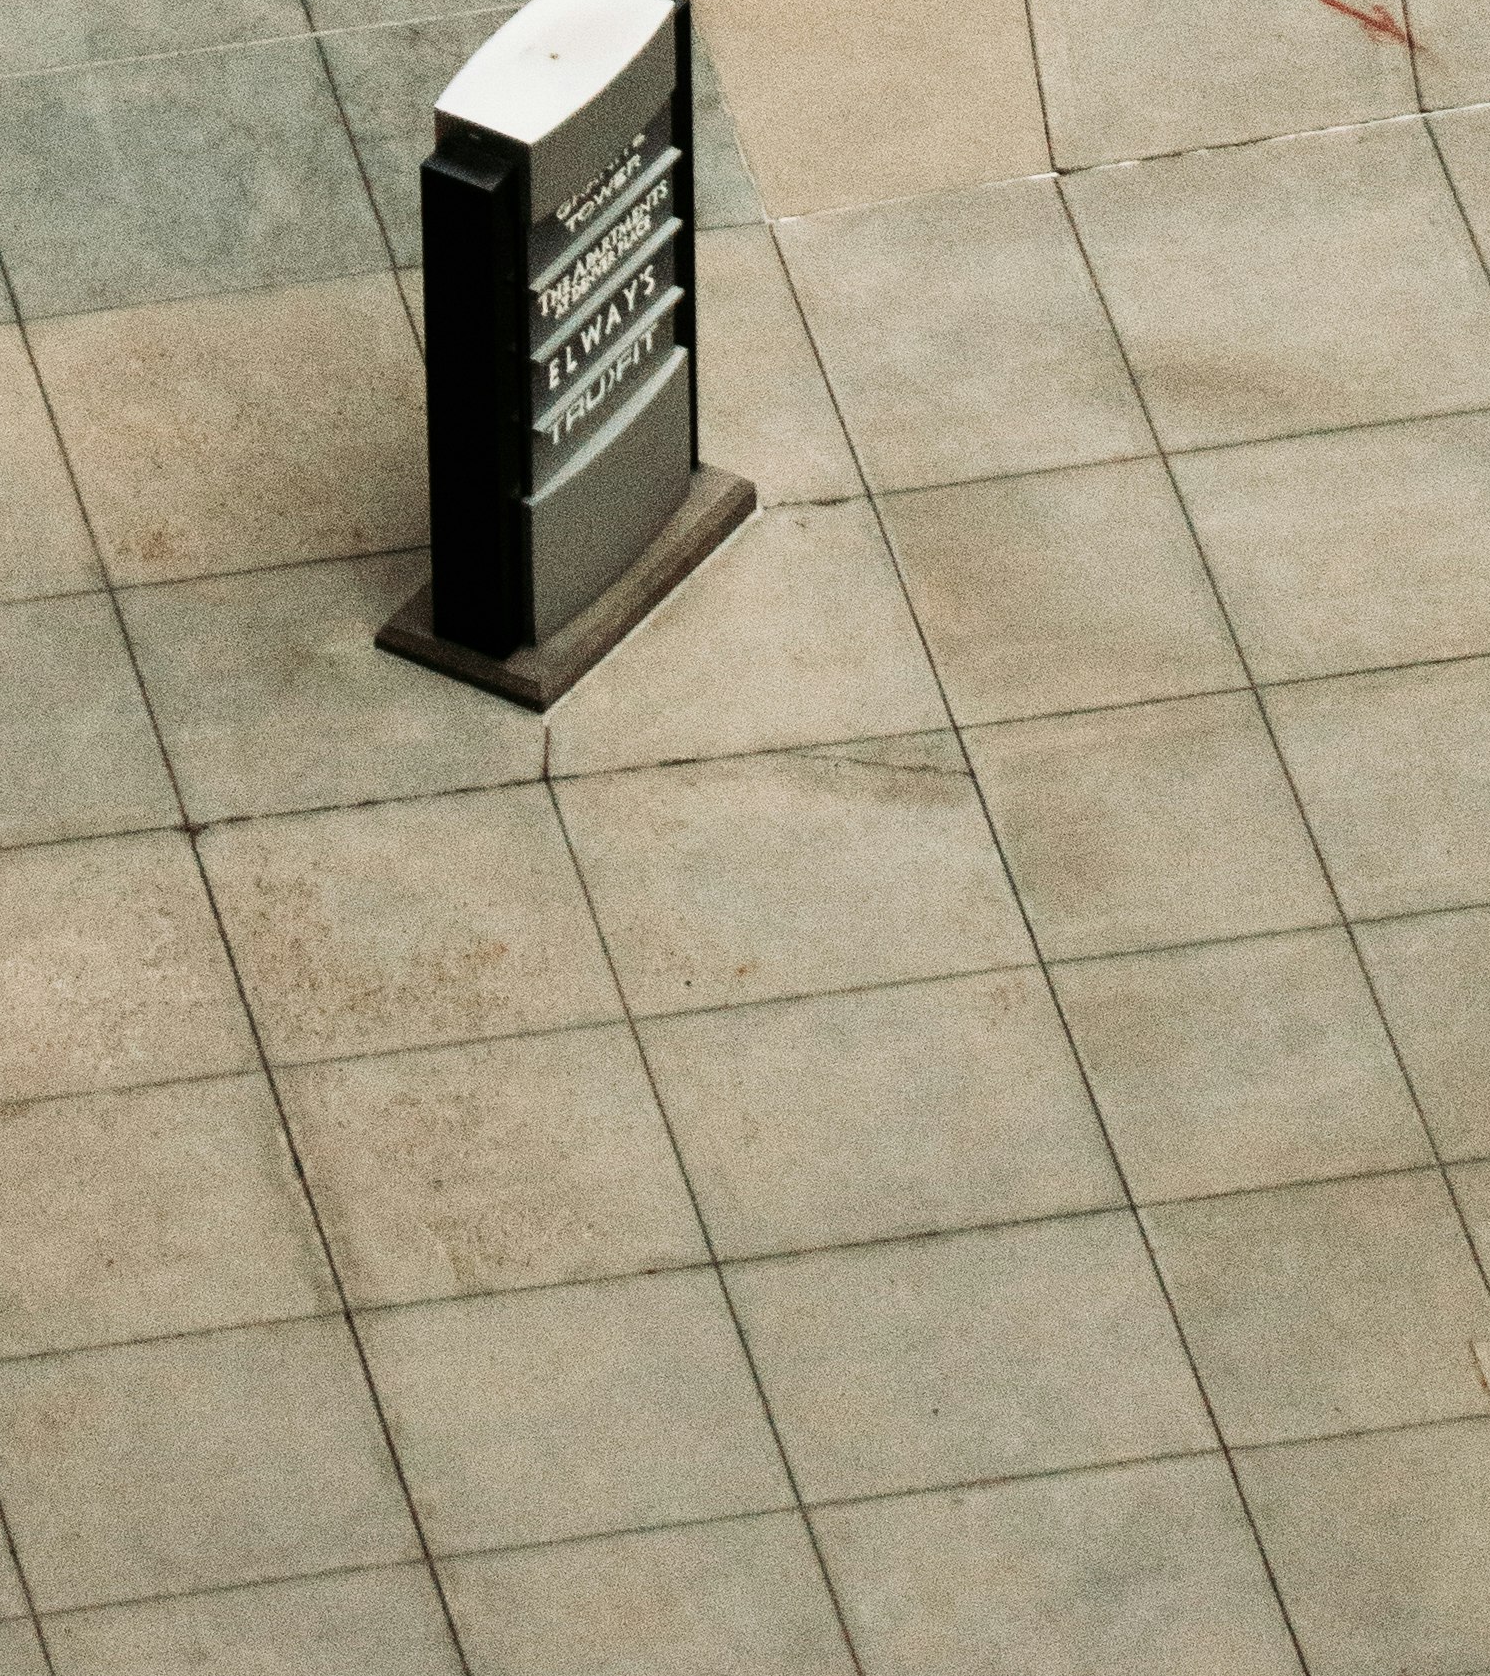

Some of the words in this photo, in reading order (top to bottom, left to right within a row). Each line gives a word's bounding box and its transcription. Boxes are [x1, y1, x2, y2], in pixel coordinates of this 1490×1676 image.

[565, 154, 642, 232] TOWER
[537, 274, 571, 317] THE
[571, 179, 669, 288] APARTMENTS
